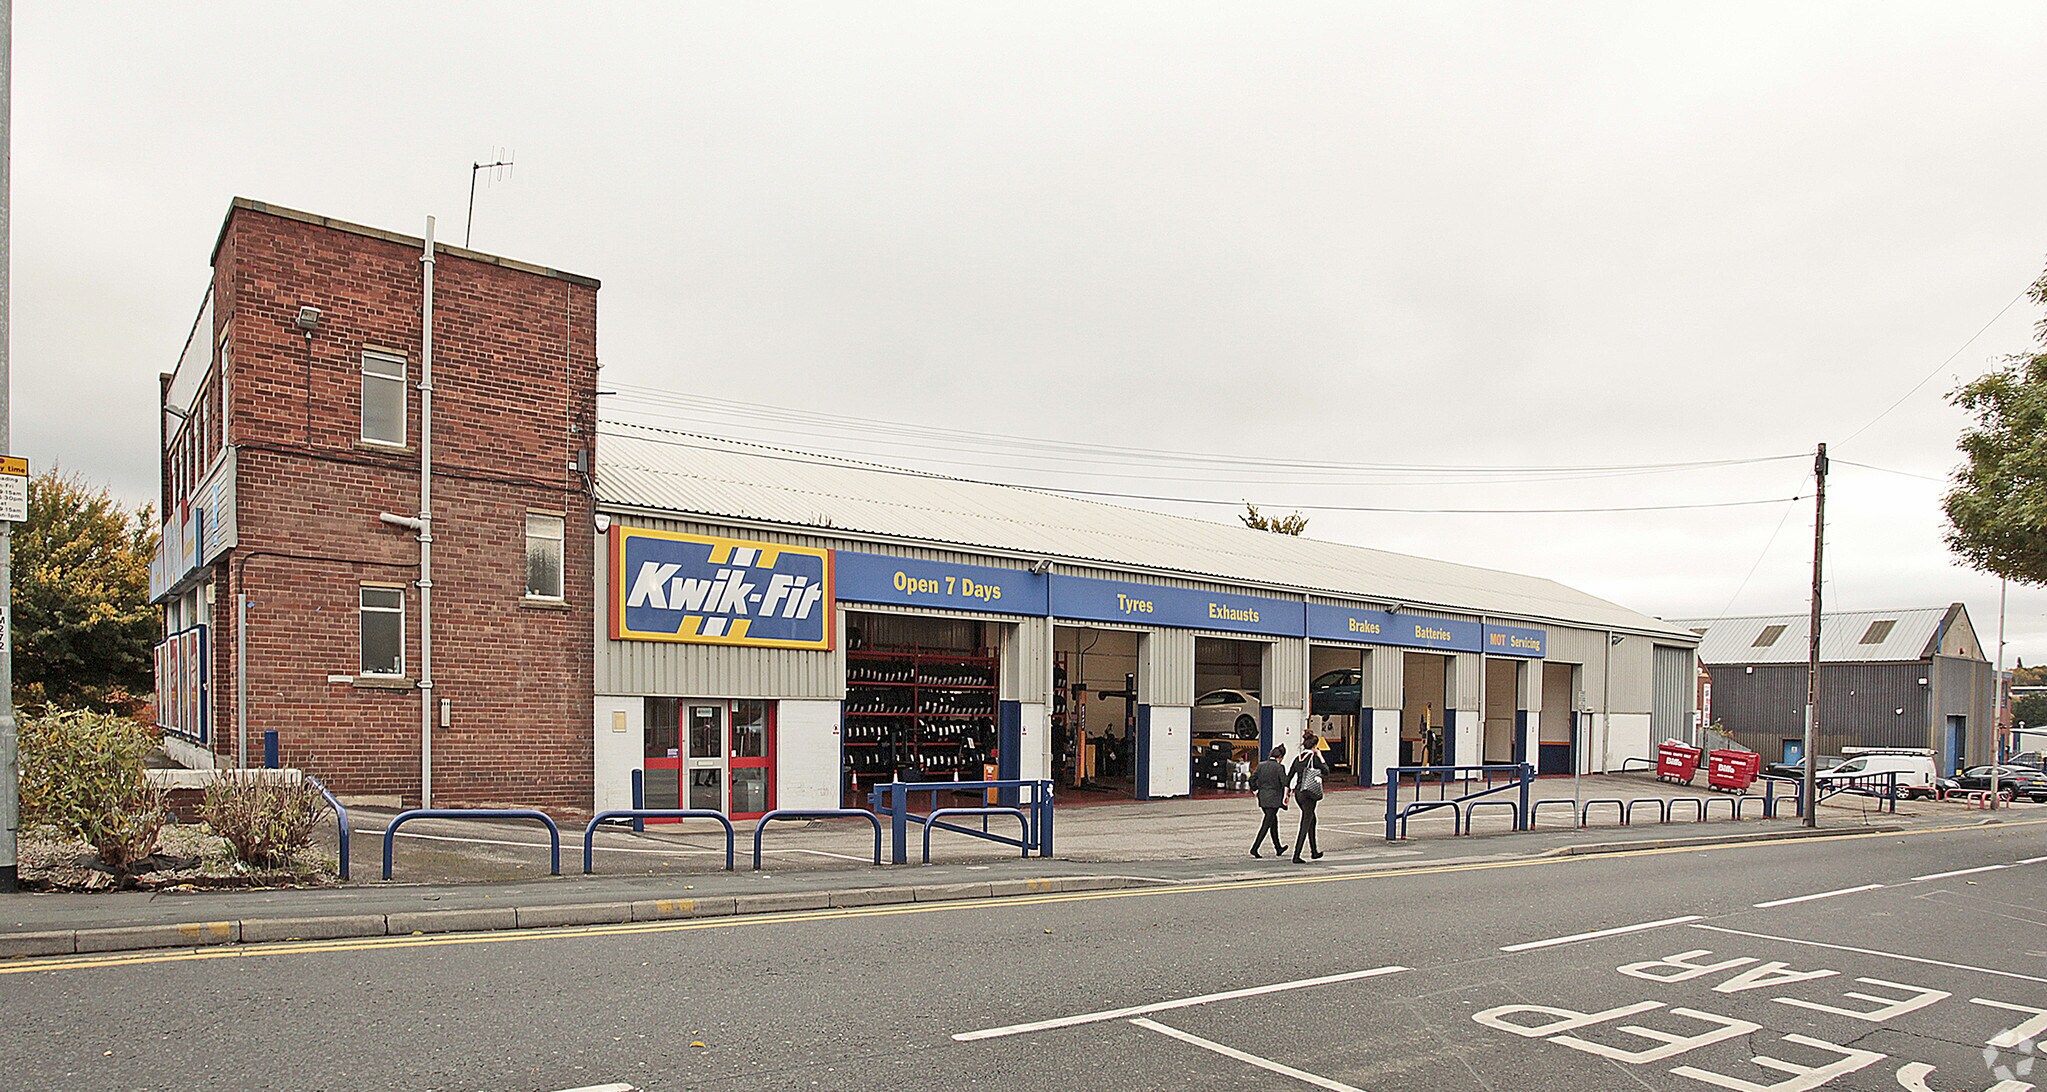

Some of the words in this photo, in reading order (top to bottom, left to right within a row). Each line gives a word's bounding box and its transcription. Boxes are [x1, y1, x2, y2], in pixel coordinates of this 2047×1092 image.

[8, 466, 26, 474] time
[627, 561, 822, 620] Kwik-Fit
[893, 571, 939, 596] Open
[945, 576, 956, 595] 7
[962, 578, 1001, 602] Days
[1117, 593, 1154, 614] Tyres
[1208, 603, 1260, 623] Exhausts
[1349, 618, 1381, 634] Brakes
[1415, 625, 1451, 641] Batteries
[1490, 633, 1506, 646] MOT
[1510, 636, 1541, 651] Servicing
[1616, 949, 2047, 1054] LEAR
